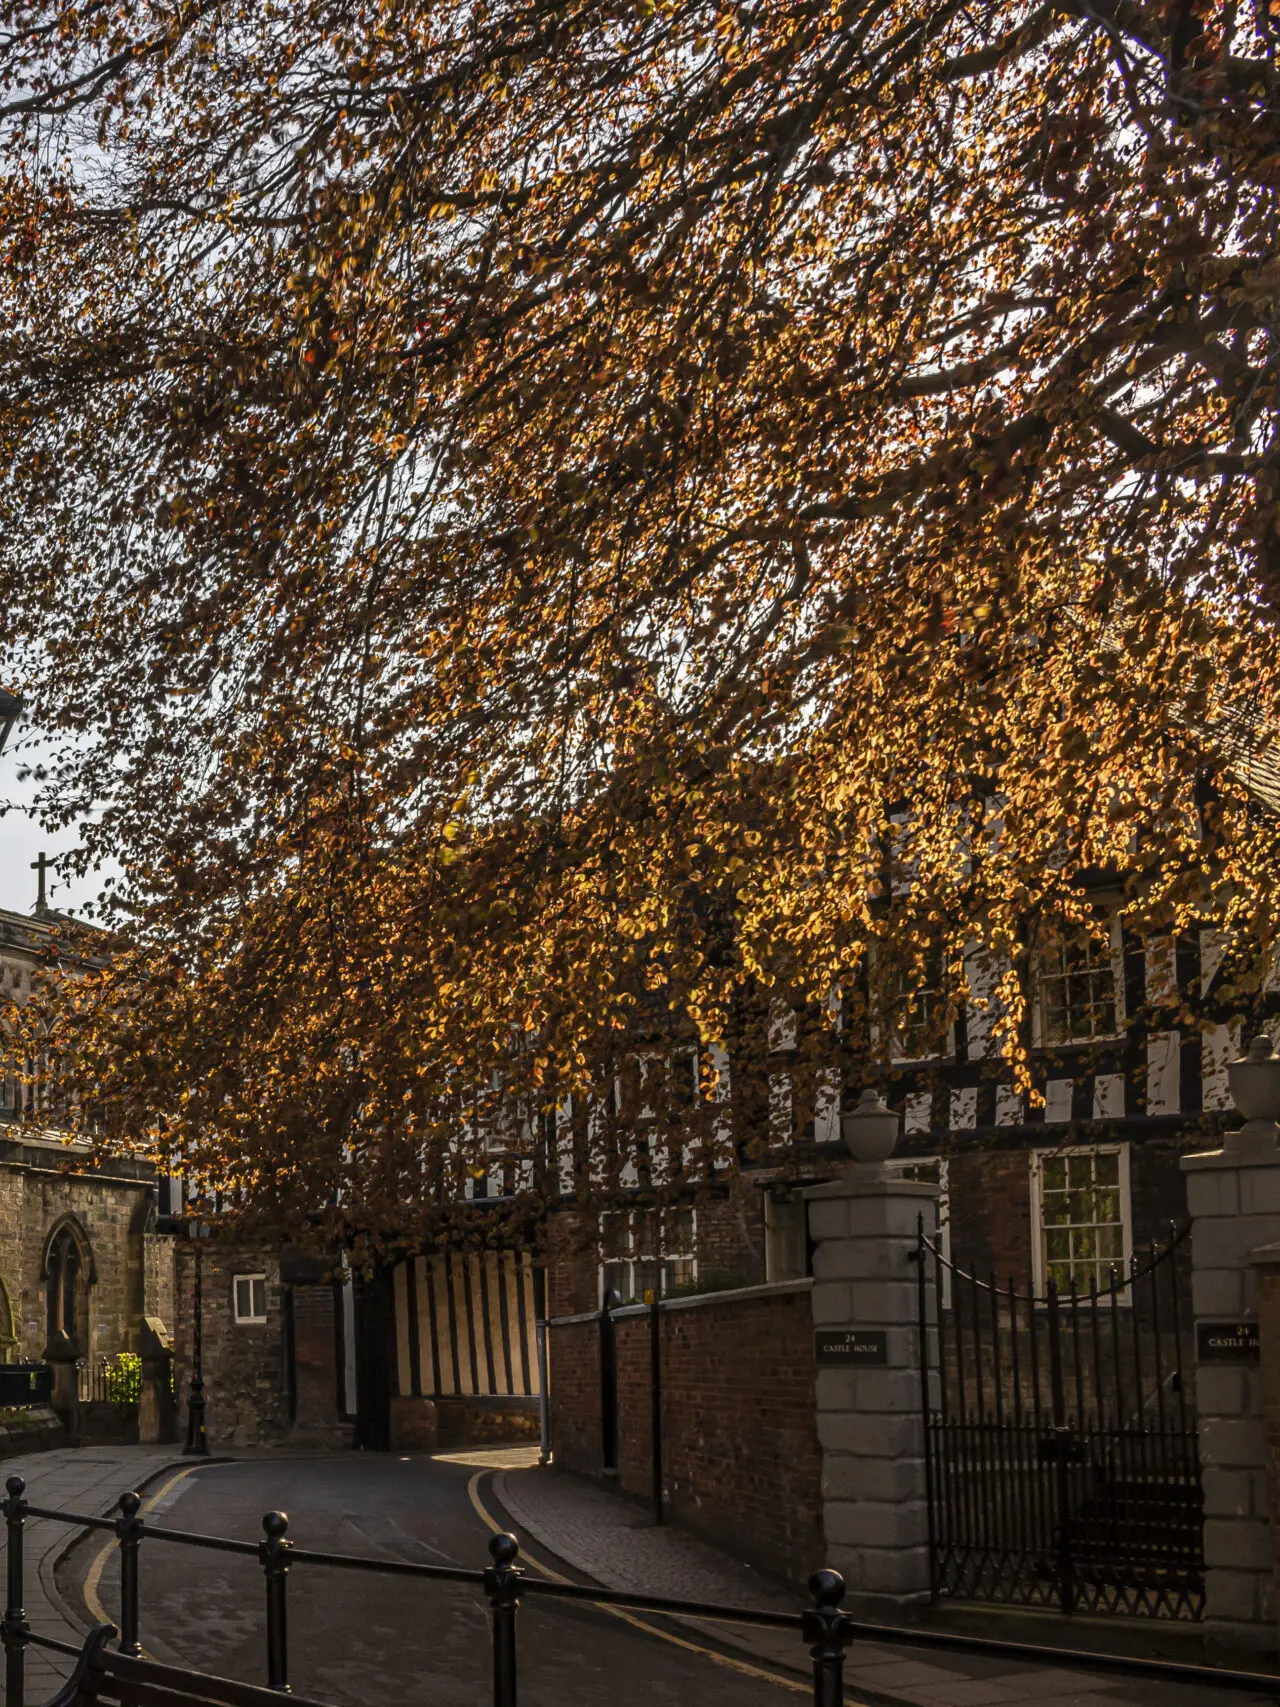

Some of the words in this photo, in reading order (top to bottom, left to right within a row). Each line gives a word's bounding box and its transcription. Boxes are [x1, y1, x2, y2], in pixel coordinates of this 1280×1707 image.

[1237, 1327, 1249, 1336] 24
[845, 1334, 856, 1343] 24
[1208, 1338, 1245, 1347] CASTLE
[823, 1344, 850, 1352] CASTLE
[854, 1344, 878, 1352] HOUSE
